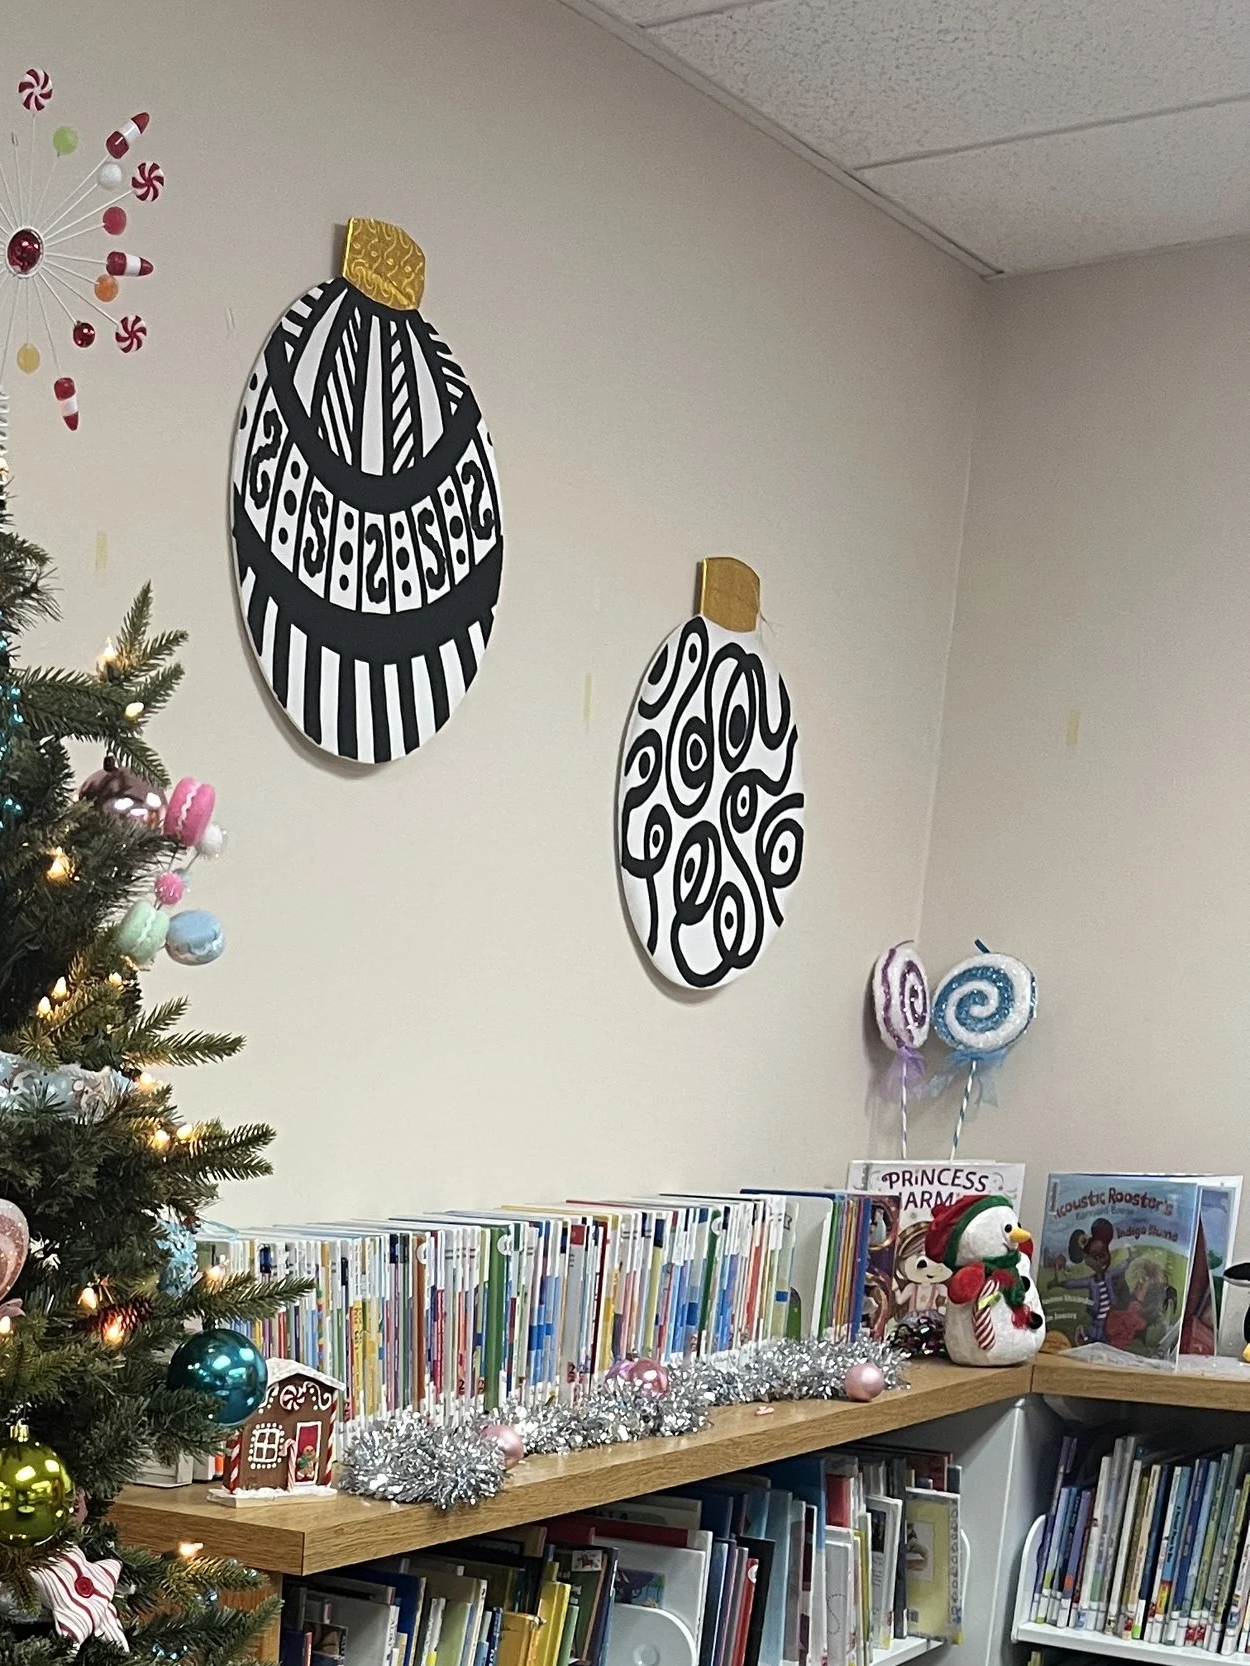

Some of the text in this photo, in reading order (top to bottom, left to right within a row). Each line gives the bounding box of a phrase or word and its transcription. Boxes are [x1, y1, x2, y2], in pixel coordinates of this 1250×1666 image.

[881, 1168, 989, 1192] PRINCESS
[899, 1191, 954, 1211] ARM
[1108, 1187, 1174, 1216] Rooster's
